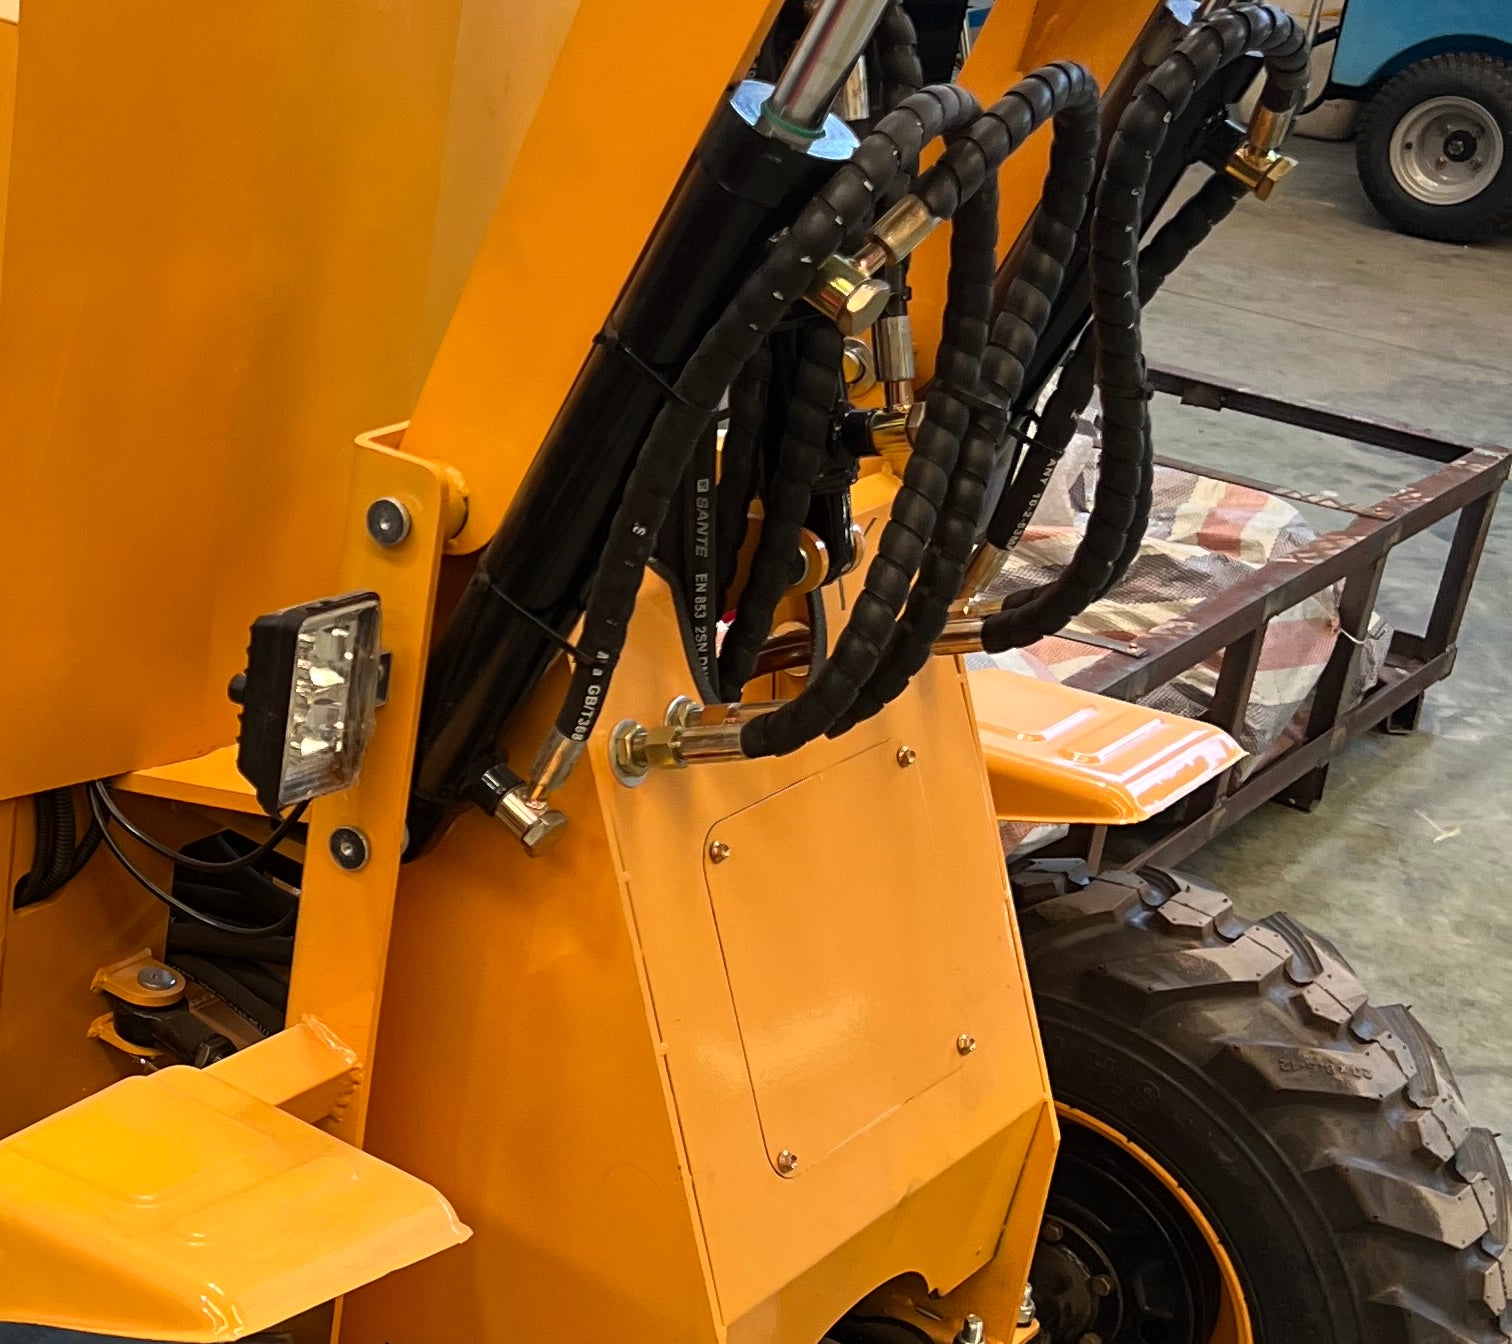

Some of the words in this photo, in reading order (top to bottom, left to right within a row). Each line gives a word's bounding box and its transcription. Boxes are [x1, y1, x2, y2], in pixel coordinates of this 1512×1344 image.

[695, 497, 709, 558] SANTE
[695, 573, 708, 593] EN
[694, 596, 707, 619] 853
